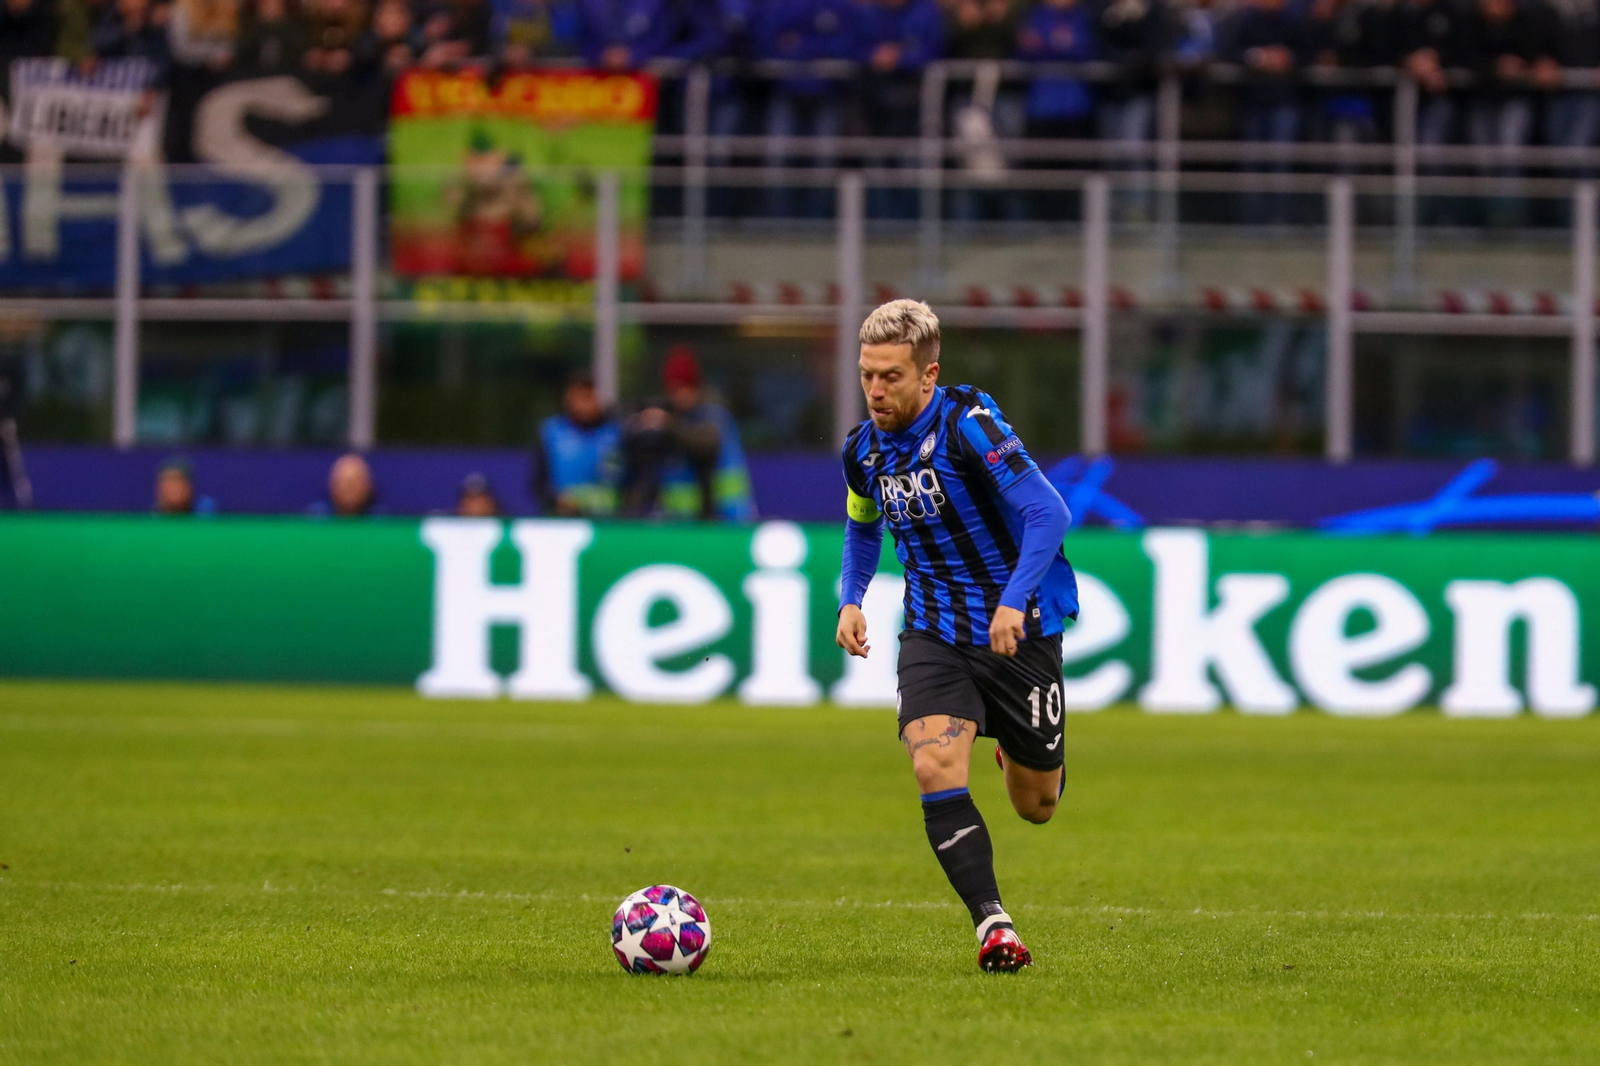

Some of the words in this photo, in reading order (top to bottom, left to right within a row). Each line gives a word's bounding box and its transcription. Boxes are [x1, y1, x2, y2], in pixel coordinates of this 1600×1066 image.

[878, 467, 941, 500] RADICI
[883, 492, 946, 522] GROUP
[1027, 682, 1061, 728] 10
